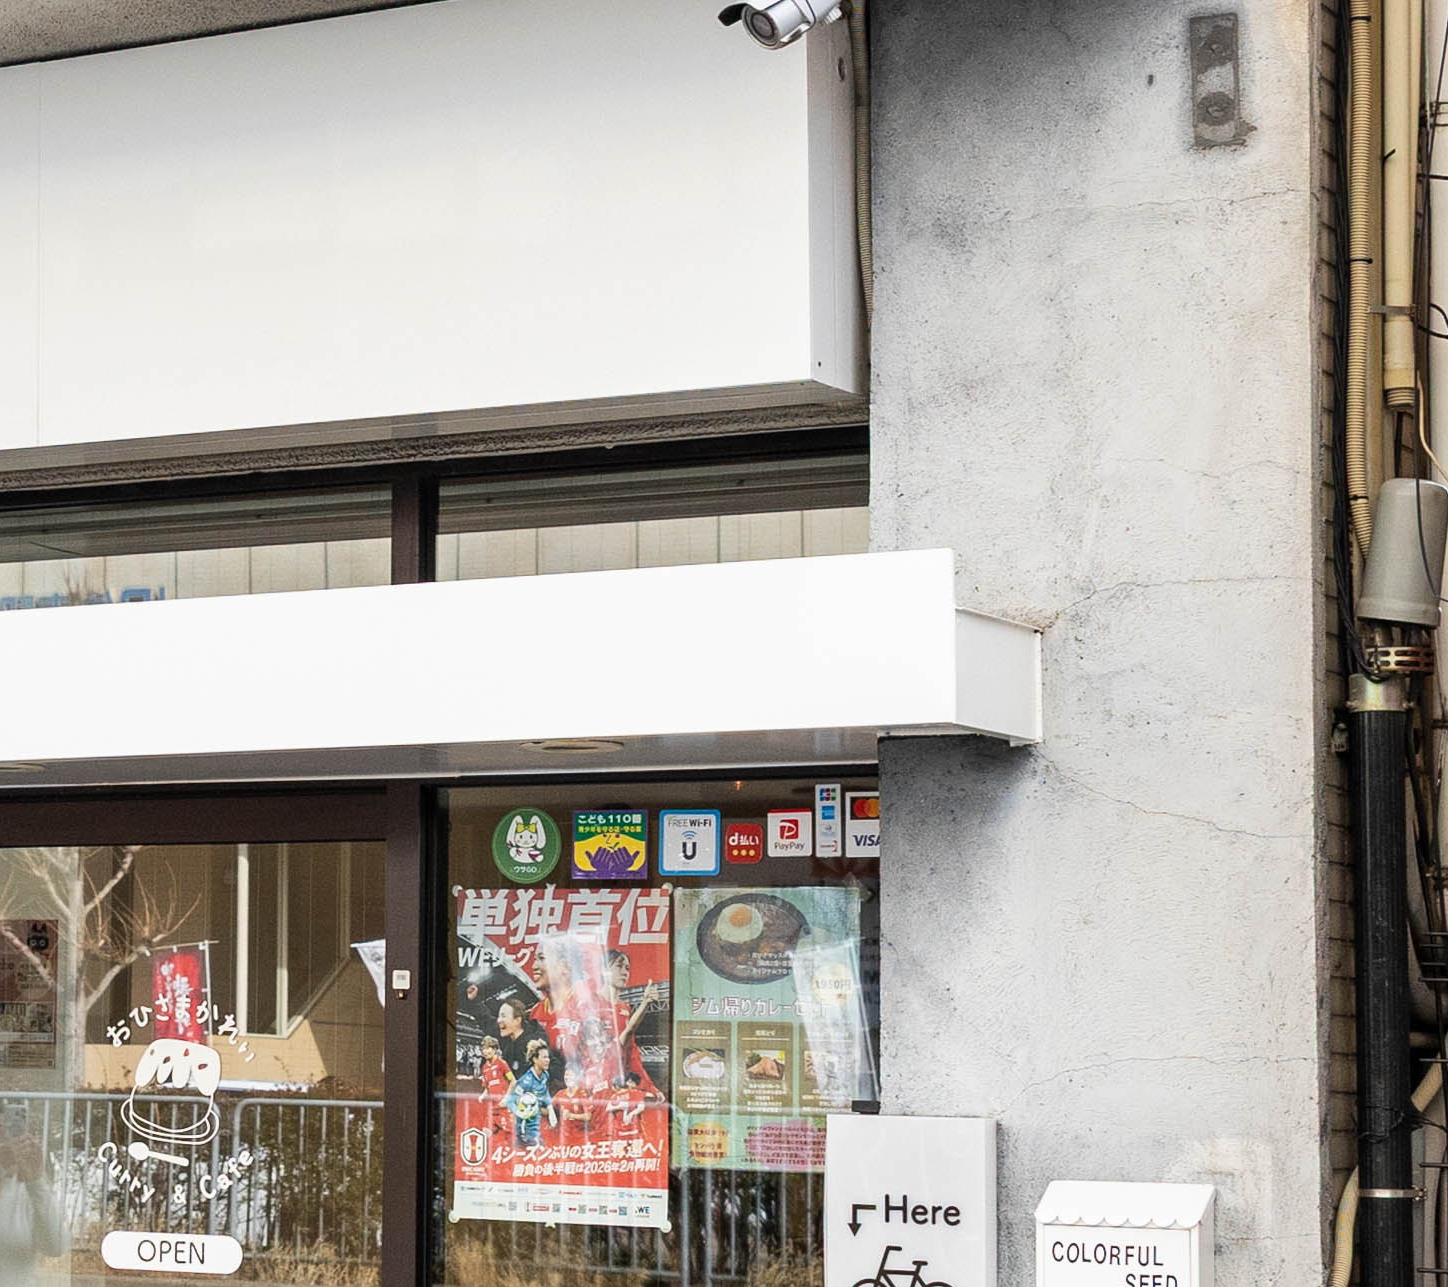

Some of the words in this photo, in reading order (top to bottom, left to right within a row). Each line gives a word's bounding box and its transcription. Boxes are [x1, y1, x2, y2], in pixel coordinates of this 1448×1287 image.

[667, 818, 689, 828] FREE
[689, 818, 713, 828] Wi-Fi
[728, 833, 760, 846] d払い
[774, 841, 805, 851] PayPay
[458, 887, 670, 947] 単独首位
[98, 1141, 155, 1203] Curry
[174, 1184, 187, 1204] &
[199, 1149, 254, 1201] Cafe
[884, 1193, 961, 1226] Here
[137, 1239, 206, 1265] OPEN
[1051, 1240, 1164, 1267] COLORFUL
